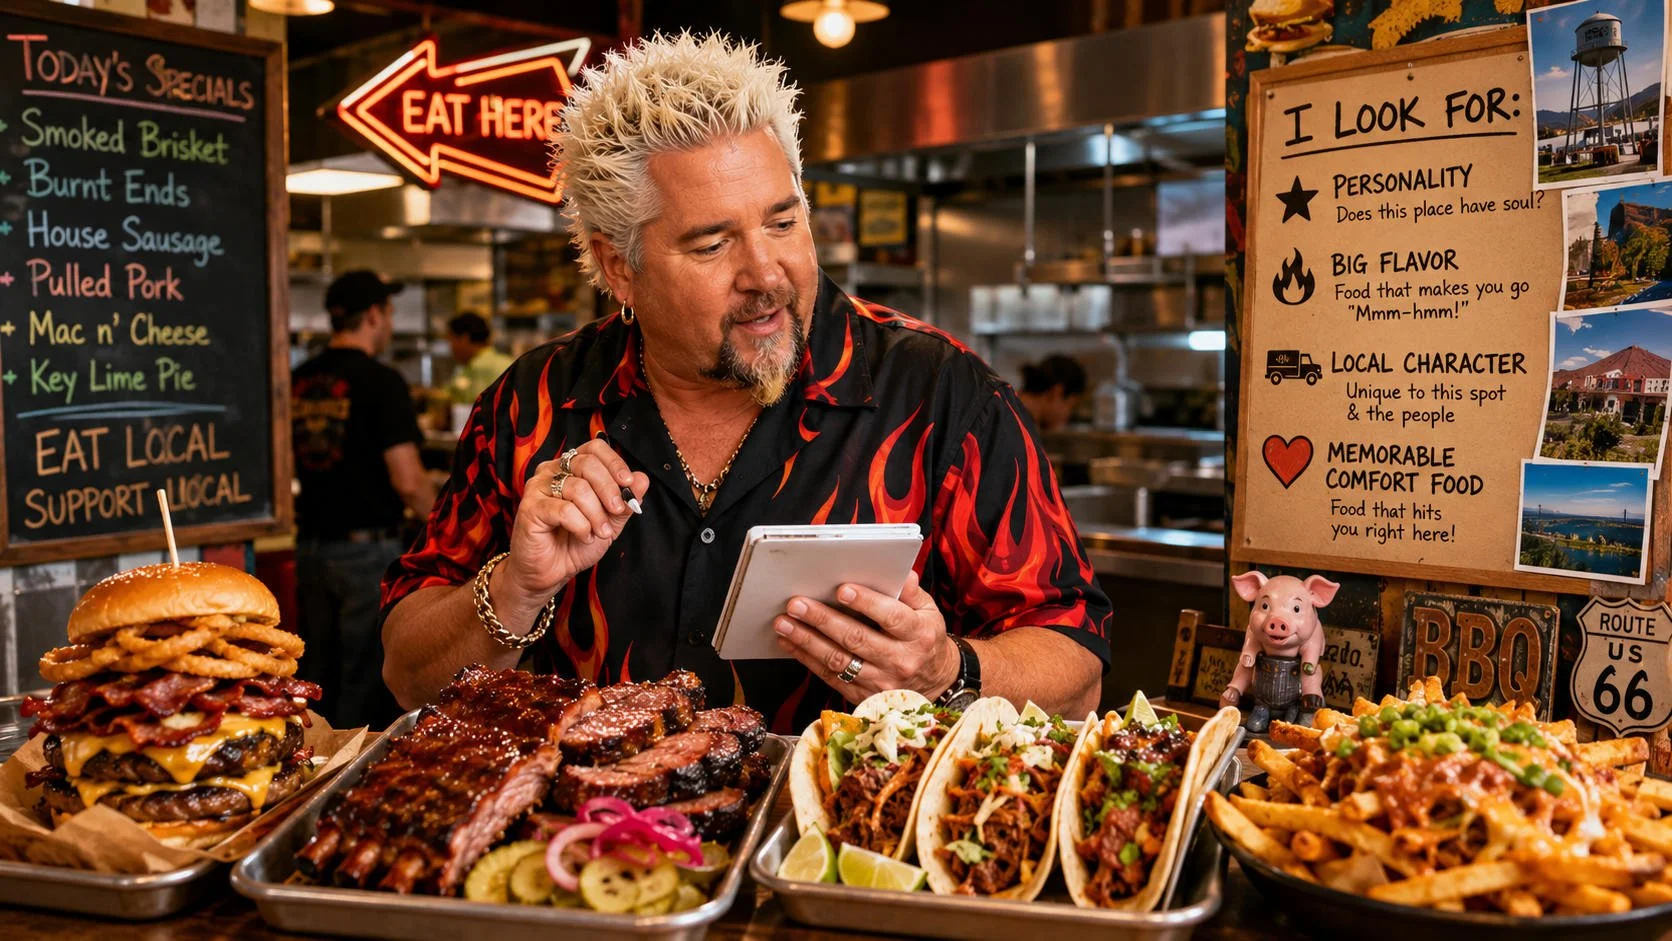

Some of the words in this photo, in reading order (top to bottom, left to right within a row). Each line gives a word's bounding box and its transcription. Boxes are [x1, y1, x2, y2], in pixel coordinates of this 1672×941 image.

[146, 54, 254, 110] SPECIALS
[402, 89, 471, 137] EAT
[480, 94, 562, 141] HERE
[1284, 103, 1313, 147] I
[1335, 96, 1426, 139] LOOK
[1445, 87, 1521, 128] FOR:
[21, 107, 126, 154] Smoked
[137, 120, 230, 165] Brisket
[23, 158, 112, 202] Burnt
[124, 169, 190, 208] Ends
[1333, 163, 1473, 199] PERSONALITY
[1336, 205, 1372, 223] Does
[1378, 202, 1407, 219] this
[1414, 200, 1453, 223] place
[1460, 197, 1497, 215] have
[1503, 190, 1545, 212] soul?
[27, 210, 111, 249] House
[122, 215, 225, 268] Sausage
[26, 258, 111, 298] Pulled
[125, 263, 184, 301] Pork
[1330, 253, 1368, 276] BIG
[1380, 249, 1459, 273] FLAVOR
[1335, 282, 1370, 300] Food
[1376, 282, 1412, 298] that
[1419, 280, 1469, 297] makes
[1475, 283, 1504, 300] you
[1510, 281, 1530, 299] go
[29, 310, 85, 346] Mac
[97, 313, 120, 345] n'
[130, 312, 210, 345] Cheese
[1348, 301, 1470, 322] "Mmm-hmm!"
[30, 358, 77, 404] Key
[90, 359, 147, 392] Lime
[155, 357, 196, 392] Pie
[1331, 351, 1393, 373] LOCAL
[1403, 352, 1527, 375] CHARACTER
[1346, 382, 1401, 405] Unique
[1408, 384, 1425, 400] to
[1431, 384, 1463, 400] this
[1469, 386, 1507, 407] spot
[1347, 404, 1359, 422] &
[1366, 405, 1394, 421] the
[1402, 406, 1455, 429] people
[35, 427, 109, 477] EAT
[126, 422, 231, 469] LOCAL
[1327, 441, 1455, 468] MEMORABLE
[1325, 468, 1419, 493] COMFORT
[1431, 473, 1484, 496] FOOD
[24, 481, 150, 529] SUPPORT
[1330, 498, 1366, 517] Food
[1372, 501, 1406, 519] that
[1413, 503, 1442, 521] hits
[1331, 523, 1358, 541] you
[1366, 523, 1405, 544] right
[1413, 525, 1456, 543] here!
[1600, 612, 1656, 636] ROUTE
[1408, 607, 1541, 710] BBQ
[1608, 642, 1643, 663] US
[1593, 664, 1653, 720] 66
